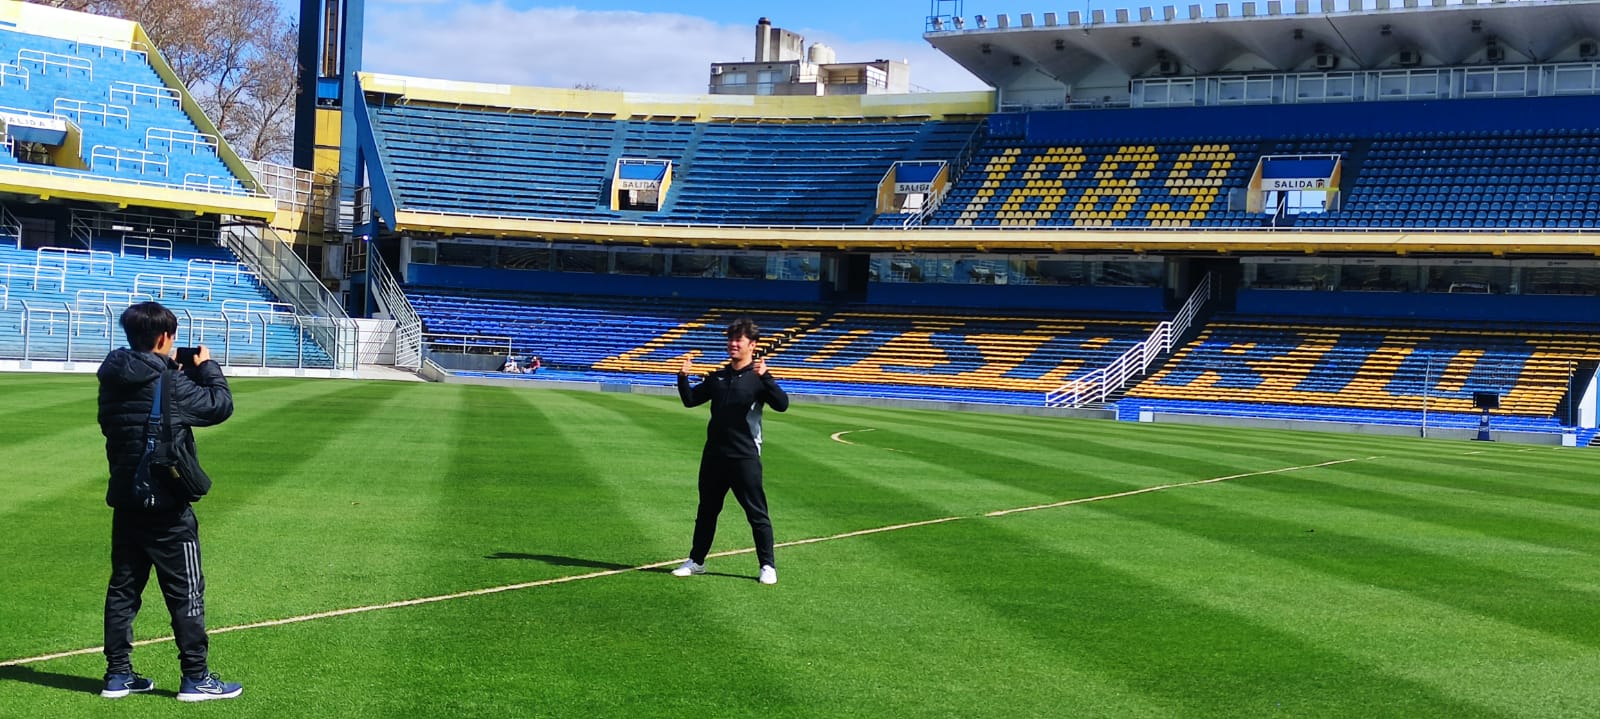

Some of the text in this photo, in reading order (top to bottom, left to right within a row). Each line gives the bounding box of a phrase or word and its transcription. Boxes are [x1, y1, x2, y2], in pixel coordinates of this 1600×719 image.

[6, 116, 46, 127] ALIDA
[622, 181, 656, 189] SALIDA
[955, 144, 1236, 227] 1889
[1274, 180, 1313, 188] SALIDA
